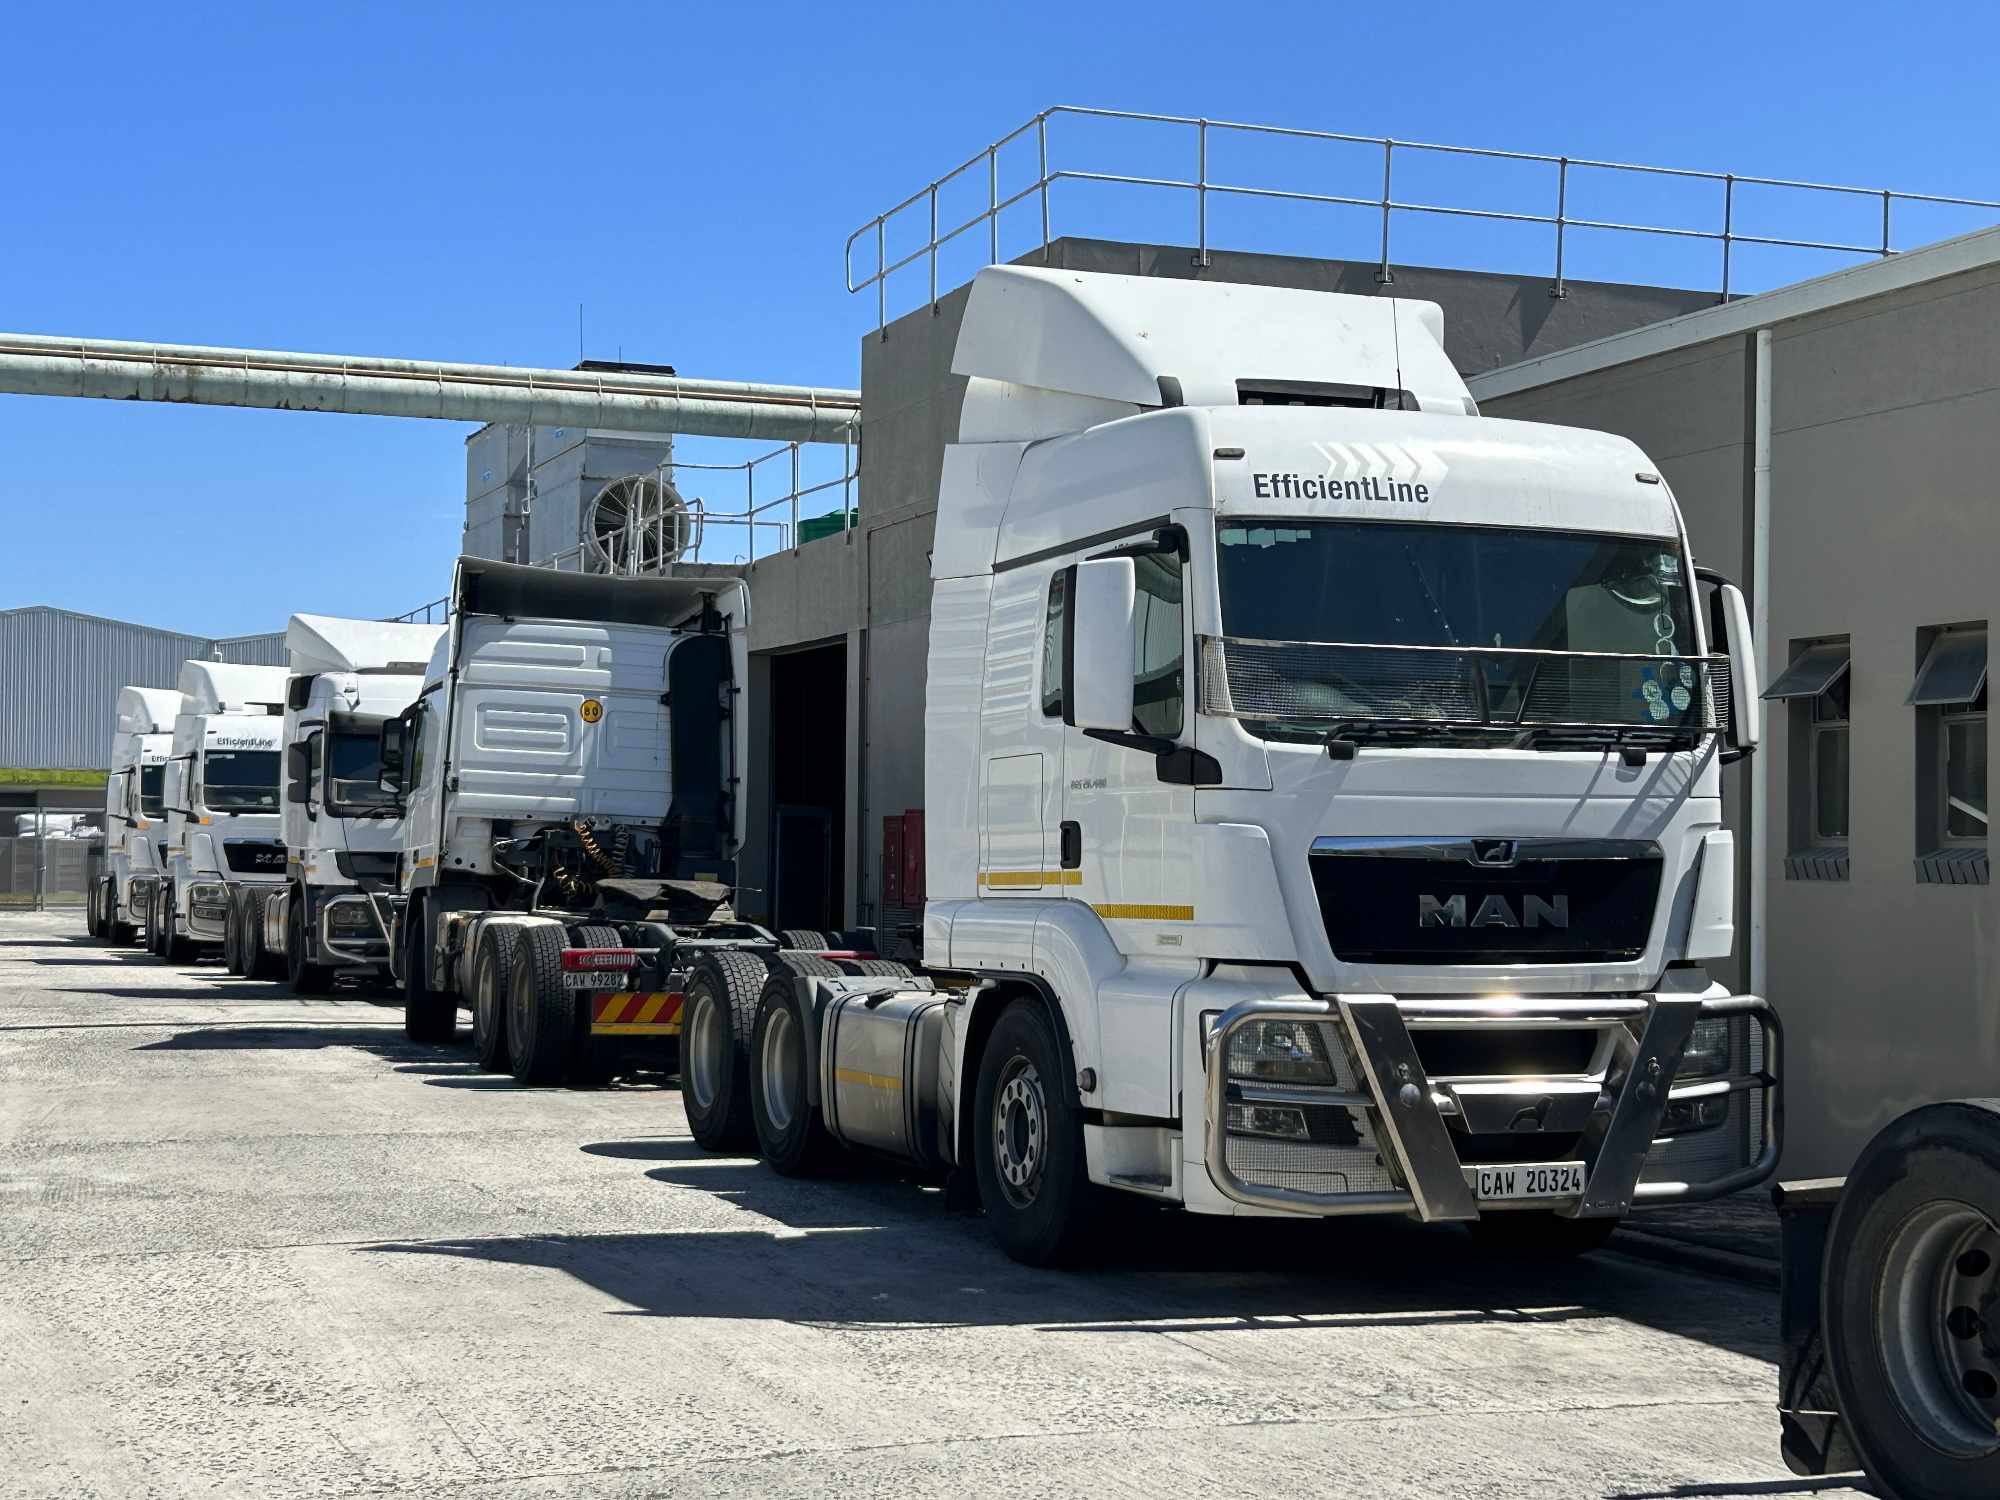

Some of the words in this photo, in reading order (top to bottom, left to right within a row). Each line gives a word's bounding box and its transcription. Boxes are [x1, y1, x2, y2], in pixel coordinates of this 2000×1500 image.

[1253, 474, 1430, 503] EfficientLine
[1419, 894, 1569, 928] MAN
[1481, 1171, 1515, 1196] CAW
[1526, 1167, 1581, 1193] 20324
